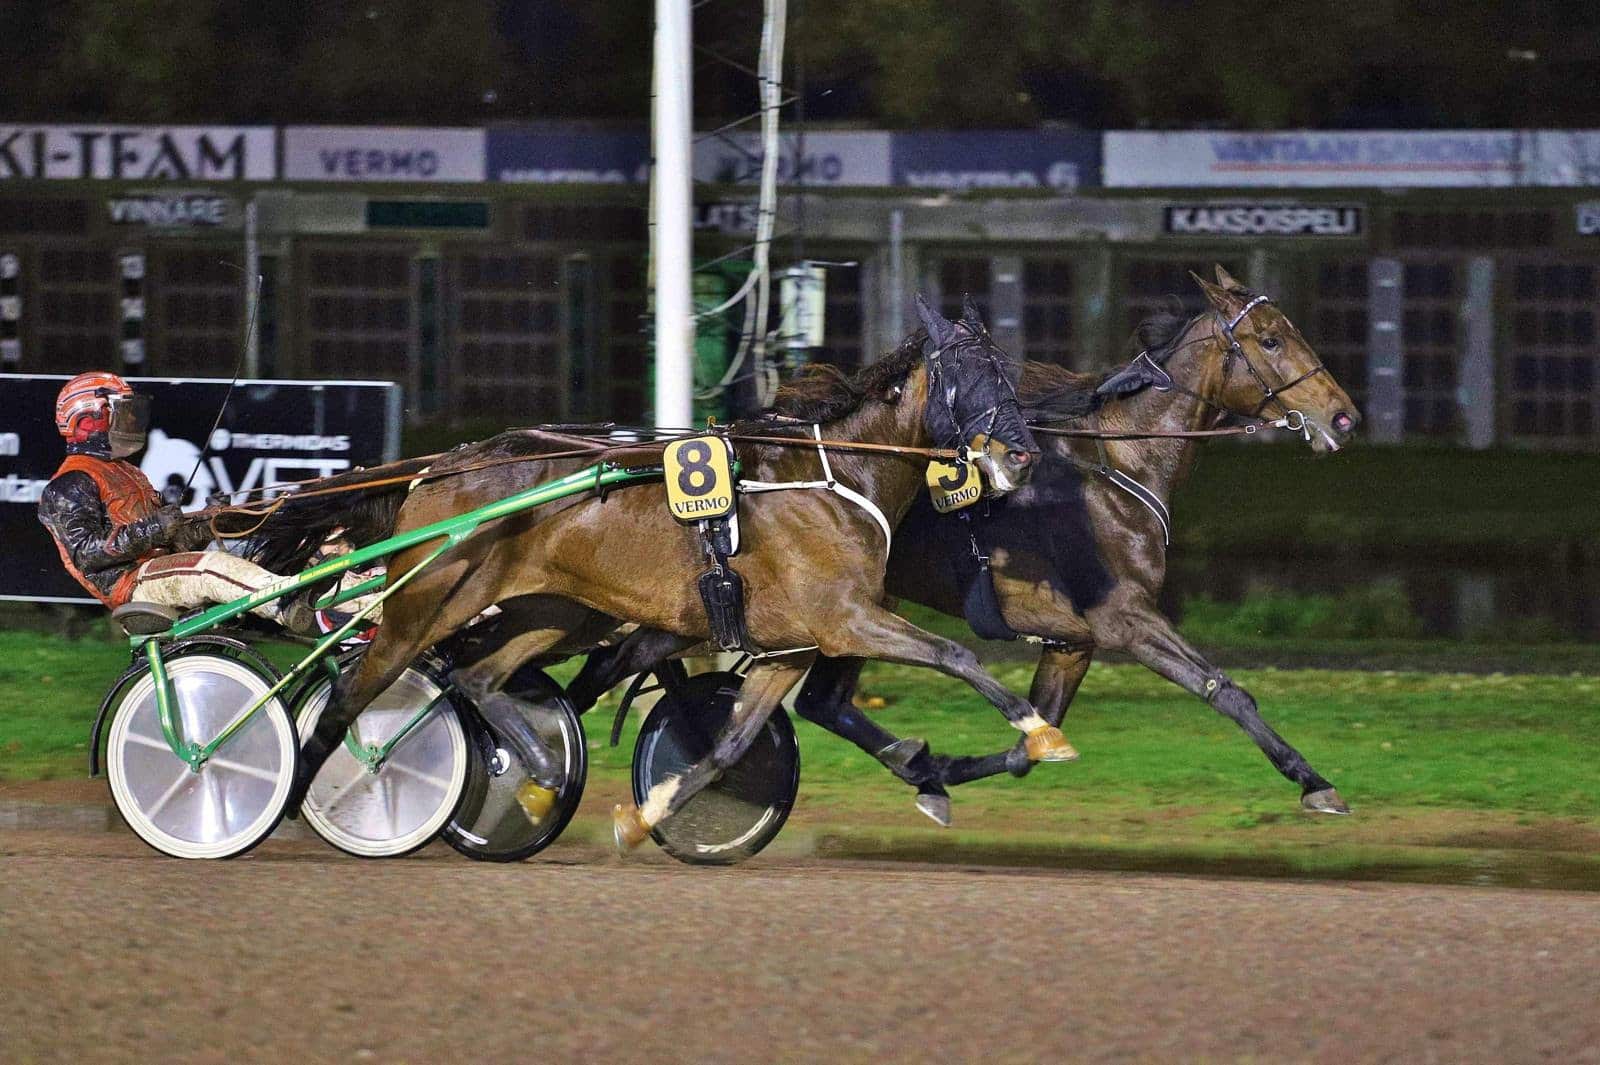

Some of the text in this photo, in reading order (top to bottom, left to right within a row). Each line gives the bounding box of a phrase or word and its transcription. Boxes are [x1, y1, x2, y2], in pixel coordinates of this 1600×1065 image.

[319, 149, 439, 177] VERMO
[1171, 207, 1357, 234] KAKSOISPELI
[676, 440, 717, 497] 8
[674, 496, 730, 514] VERMO
[934, 486, 979, 510] VERMO
